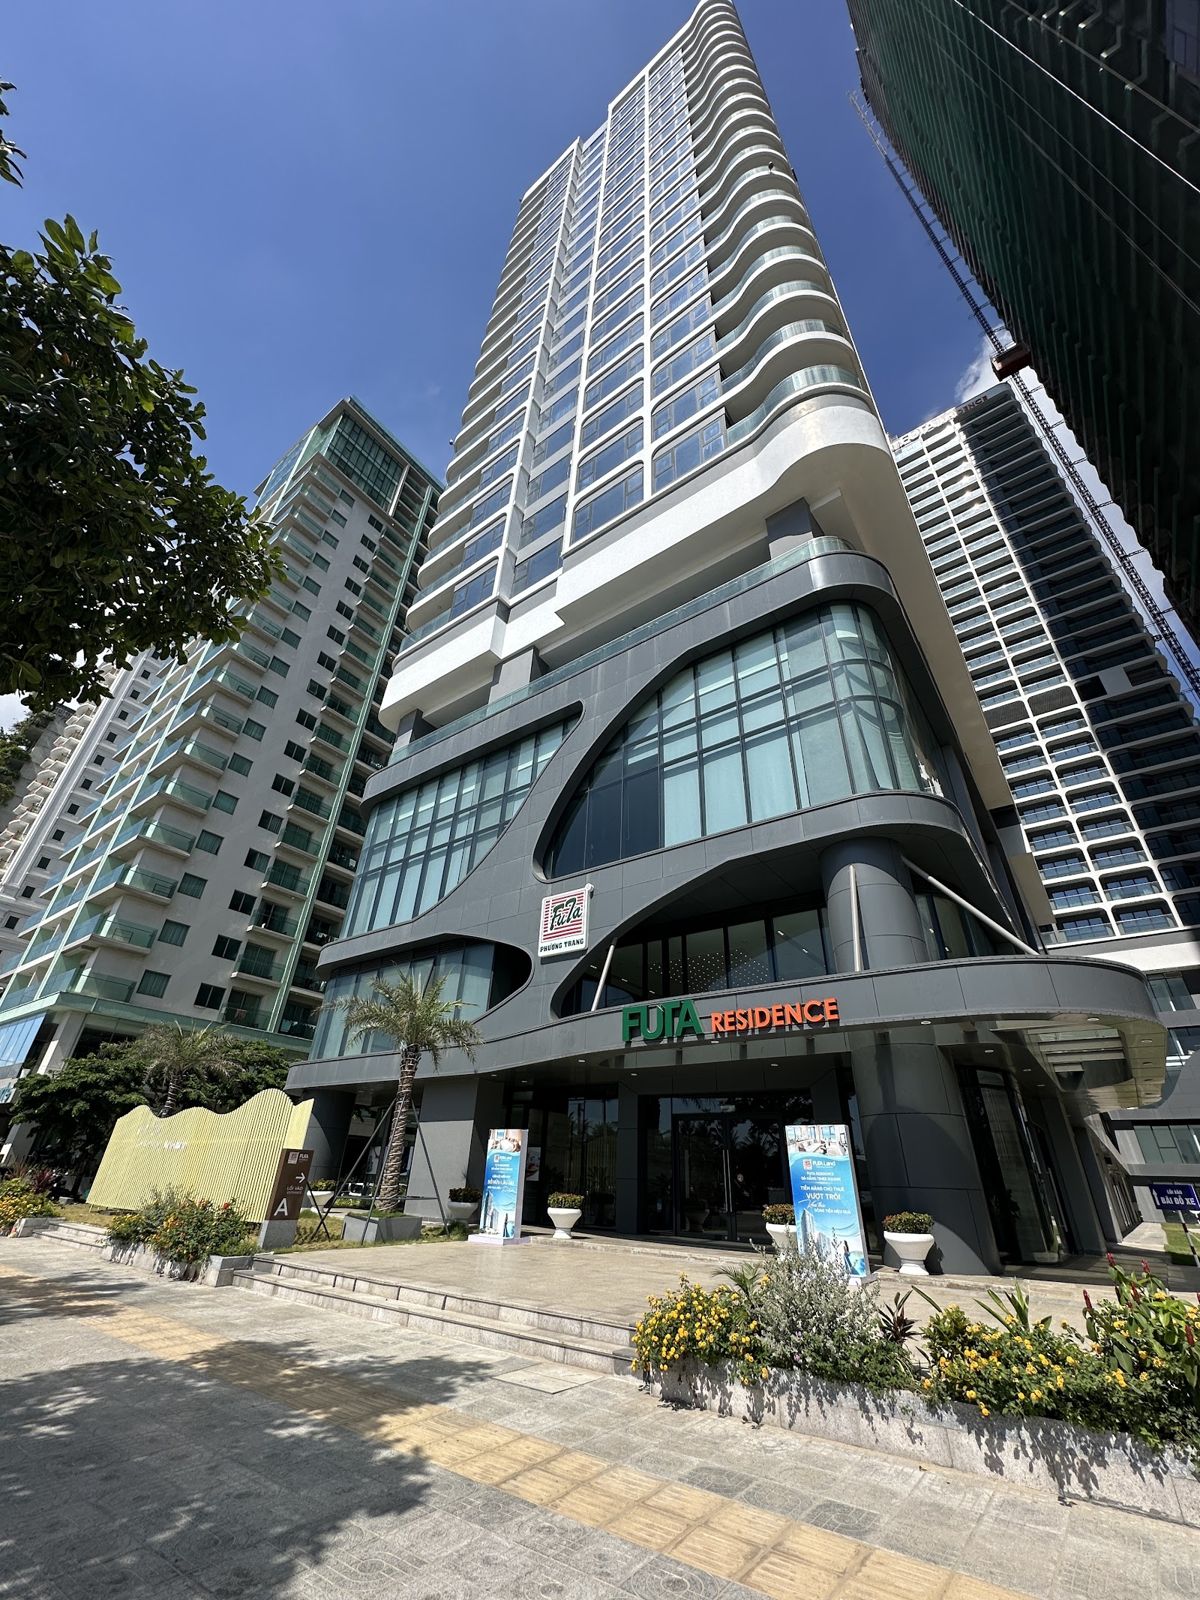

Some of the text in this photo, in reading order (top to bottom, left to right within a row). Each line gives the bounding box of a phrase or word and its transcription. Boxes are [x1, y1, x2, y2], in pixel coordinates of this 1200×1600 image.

[564, 938, 584, 948] TRANG
[622, 998, 840, 1042] FUTA RESIDENCE
[274, 1198, 288, 1216] A
[1184, 1197, 1196, 1206] XE
